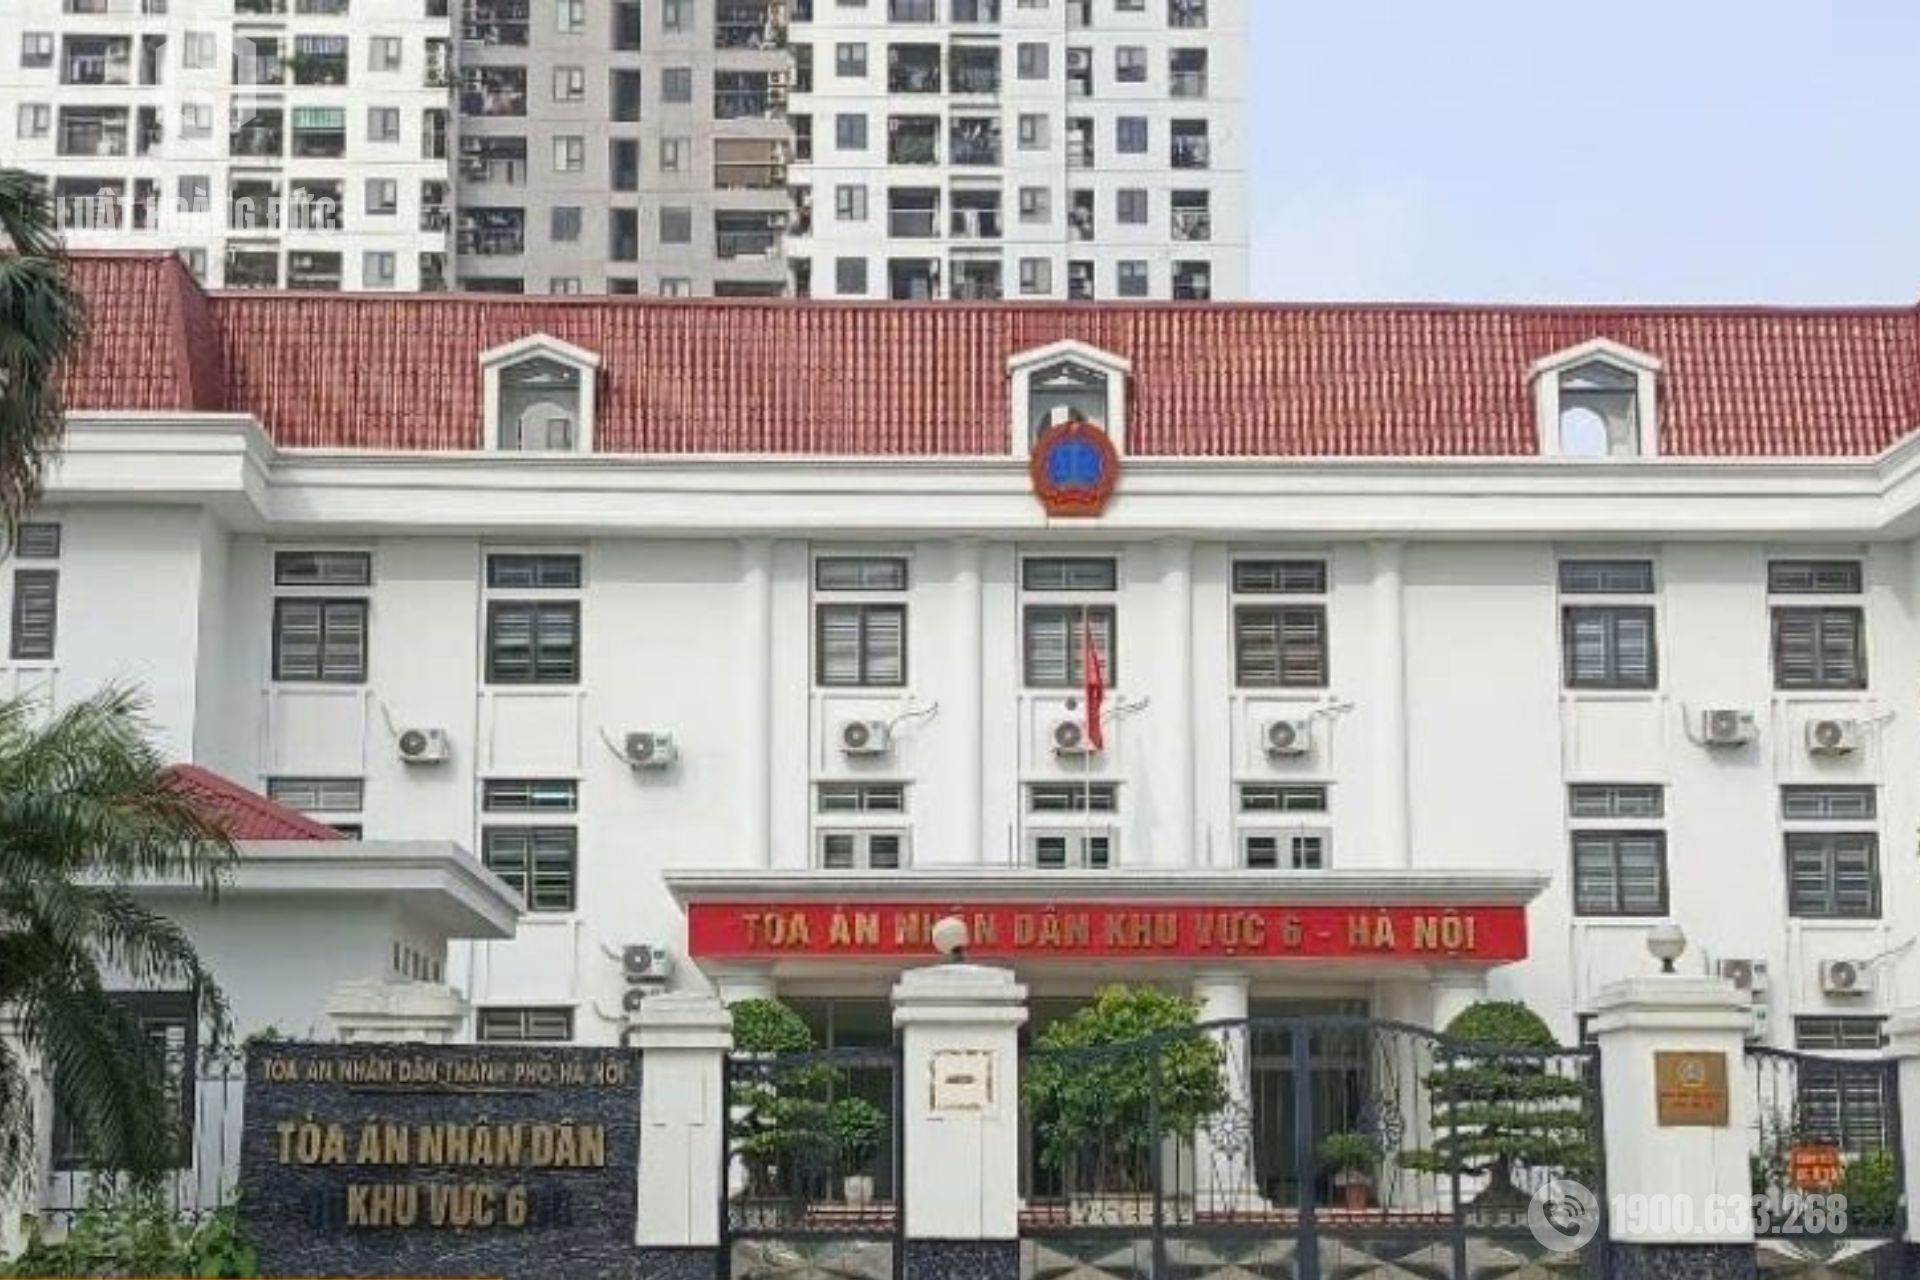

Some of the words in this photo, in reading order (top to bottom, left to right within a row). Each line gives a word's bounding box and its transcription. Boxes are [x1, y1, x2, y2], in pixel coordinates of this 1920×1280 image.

[895, 906, 997, 945] NHN
[1014, 904, 1090, 947] DÂN
[1105, 913, 1178, 947] KHU
[1280, 914, 1301, 947] 6
[1350, 908, 1395, 947] HÀ
[1412, 908, 1476, 955] NỘI
[357, 1113, 408, 1165] ÁN
[417, 1114, 520, 1166] NHÂN
[526, 1117, 604, 1167] DÂN
[348, 1183, 417, 1226] KHU
[431, 1184, 495, 1234] VỰC
[506, 1184, 527, 1226] 6
